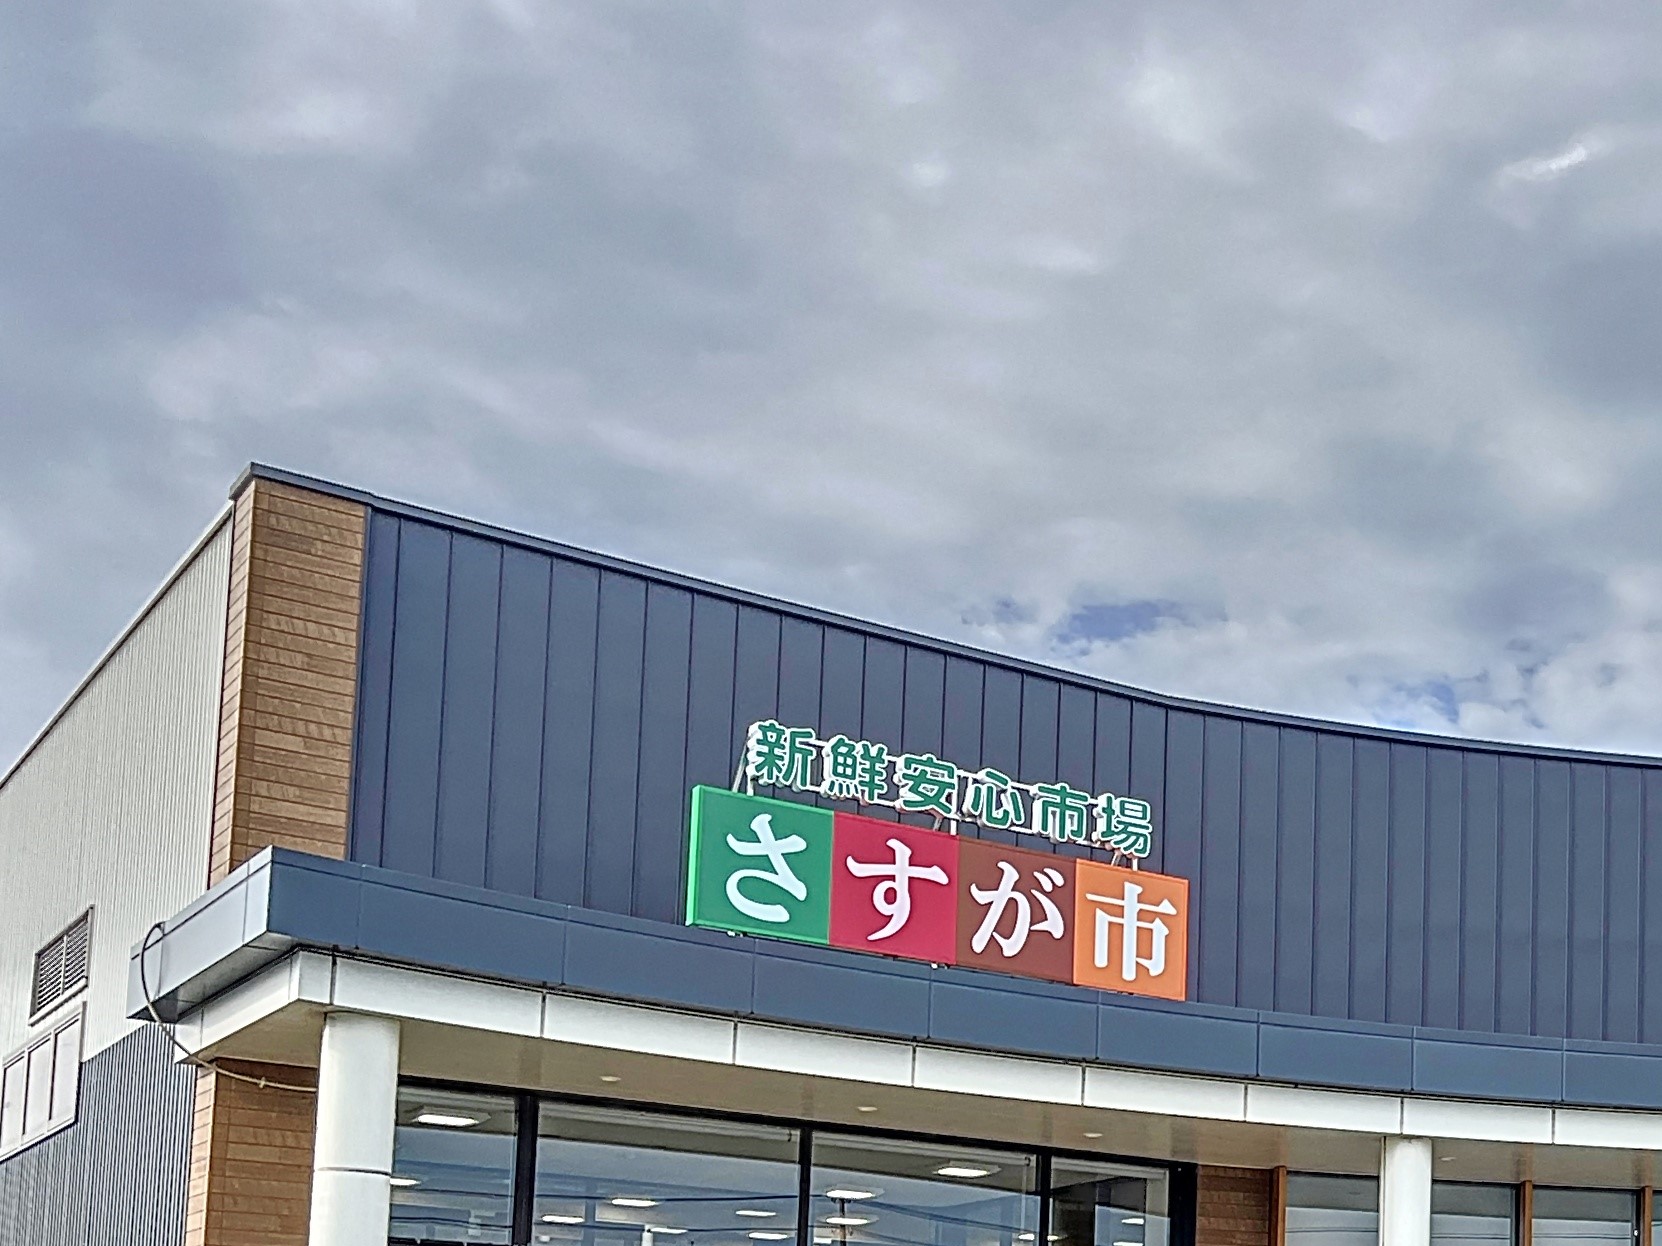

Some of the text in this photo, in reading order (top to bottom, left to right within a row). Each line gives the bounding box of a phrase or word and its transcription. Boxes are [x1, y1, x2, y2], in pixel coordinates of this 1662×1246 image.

[752, 720, 1153, 857] 新鮮安心市場
[725, 812, 1178, 982] さすが市
